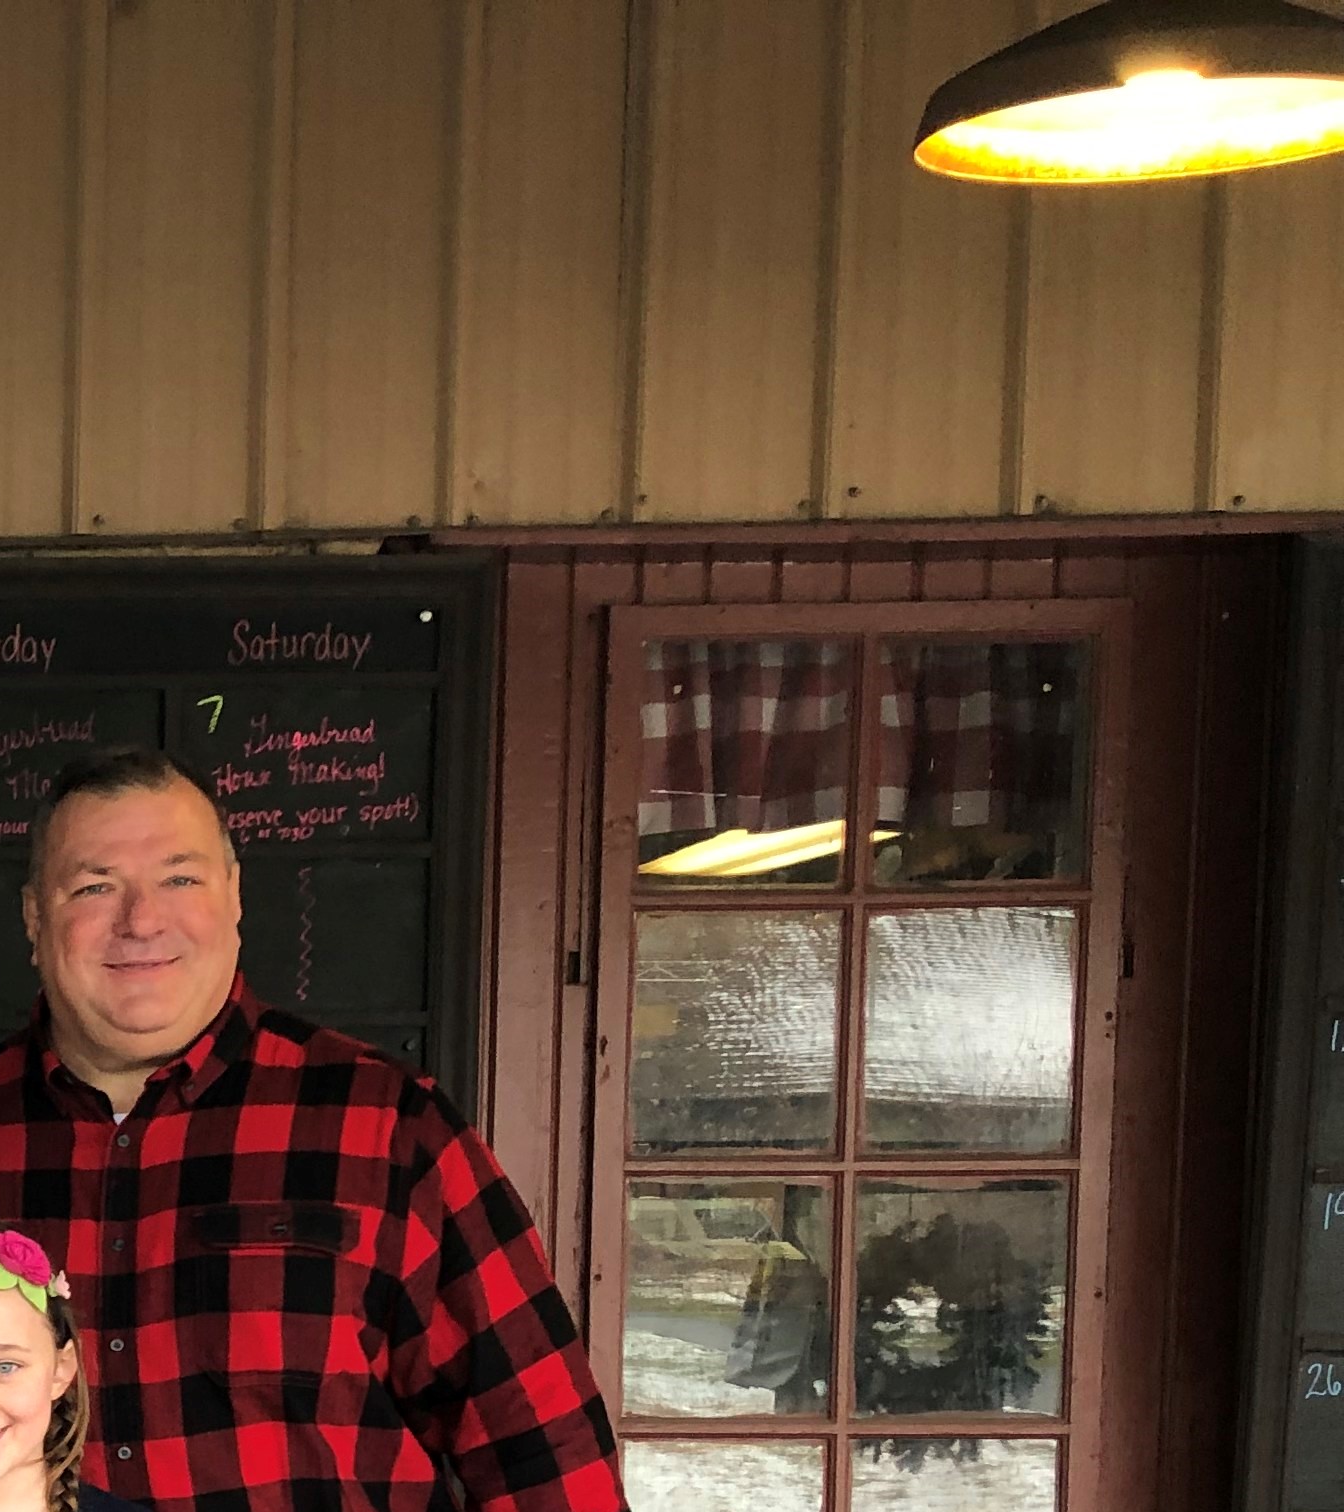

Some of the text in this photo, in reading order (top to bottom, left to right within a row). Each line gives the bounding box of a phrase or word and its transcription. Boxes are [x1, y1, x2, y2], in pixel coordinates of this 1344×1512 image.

[227, 620, 373, 668] Saturday
[196, 695, 224, 734] 7
[226, 808, 283, 830] eserve
[297, 806, 348, 825] your
[1305, 1363, 1342, 1399] 26
